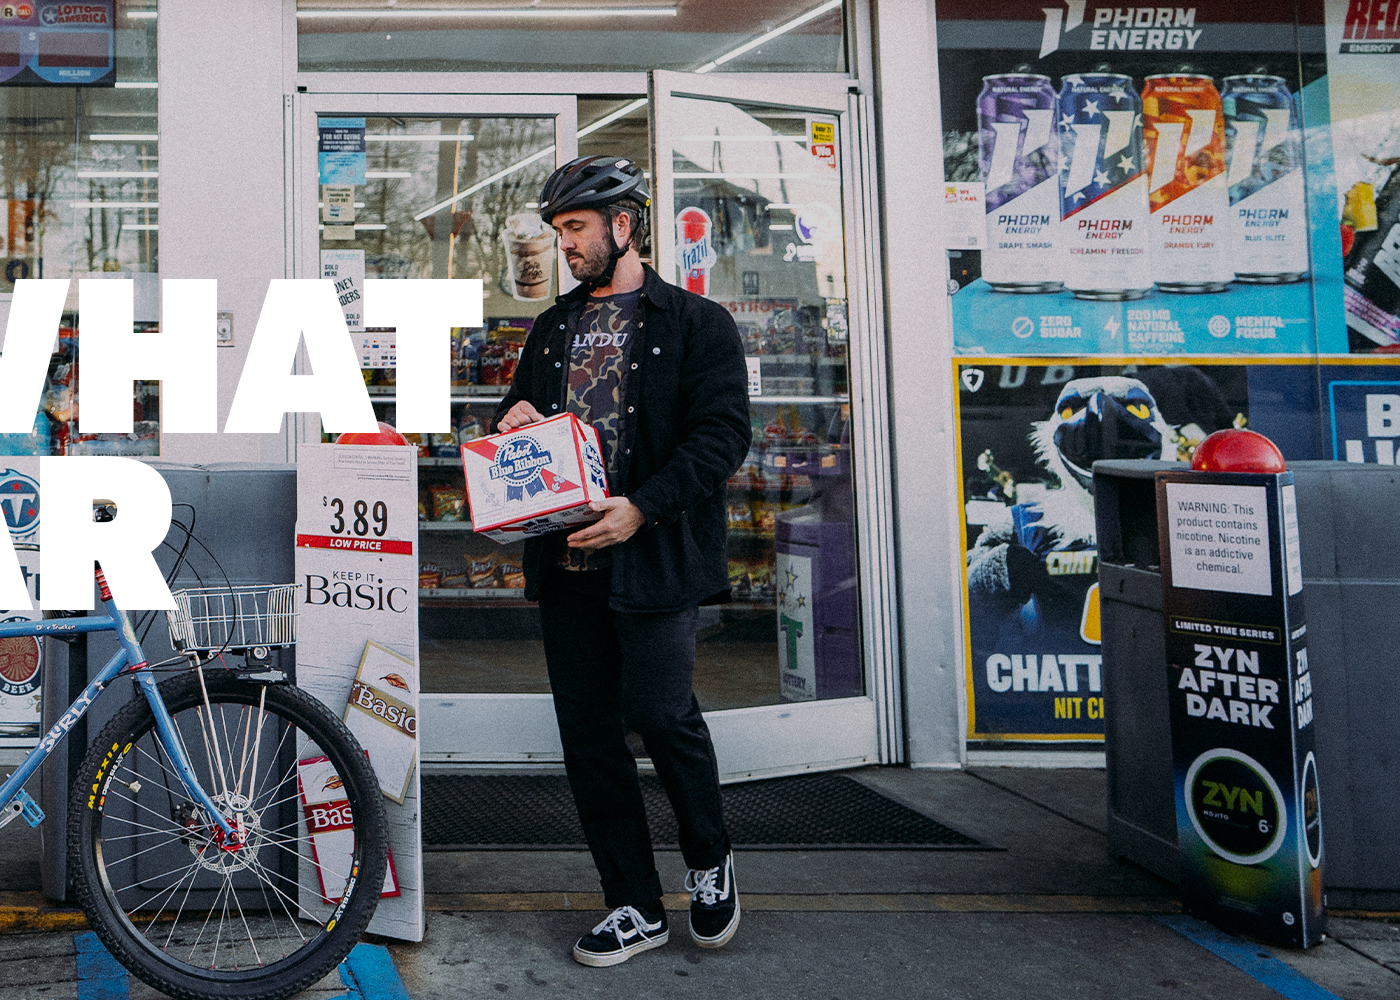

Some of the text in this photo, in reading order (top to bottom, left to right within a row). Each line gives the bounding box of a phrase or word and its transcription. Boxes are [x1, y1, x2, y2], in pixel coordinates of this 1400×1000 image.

[57, 5, 91, 13] LOTTO
[57, 12, 108, 24] AMERICA
[1093, 7, 1197, 29] PHORM
[1089, 29, 1202, 51] ENERGY
[1349, 43, 1394, 53] ENERGY
[59, 69, 90, 77] MILLION
[998, 215, 1050, 226] PHORM
[1162, 215, 1214, 226] PHORM
[1238, 209, 1289, 220] PHORM
[1078, 219, 1133, 231] PHORM
[1085, 232, 1123, 240] ENERGY
[1039, 316, 1072, 327] ZERO
[1127, 321, 1182, 332] NATURAL
[1235, 316, 1285, 327] MENTAL
[1040, 327, 1082, 338] SUGAR
[1128, 331, 1186, 343] CAFFEINE
[1235, 327, 1276, 338] FOCUS
[503, 441, 533, 462] Pabst
[491, 454, 550, 480] Blue Ribbon
[1178, 501, 1254, 515] WARNING: This
[1177, 517, 1258, 530] product contains
[330, 539, 382, 550] LOW PRICE
[1176, 531, 1261, 546] nicotine. Nicotine
[1184, 545, 1254, 560] is an addictive
[1196, 561, 1243, 574] chemical.
[333, 570, 376, 582] KEEP IT
[304, 573, 408, 613] Basic
[1175, 621, 1275, 640] LIMITED TIME SERIES
[1194, 643, 1260, 675] ZYN
[2, 682, 34, 694] BEER
[1178, 667, 1279, 704] AFTER
[356, 685, 417, 734] Basic
[1186, 693, 1275, 729] DARK
[40, 691, 91, 753] SURLY
[88, 742, 119, 810] MAXXIS
[1202, 780, 1264, 816] ZYN
[313, 806, 353, 830] Bas
[1203, 810, 1229, 820] MOJITO
[1258, 819, 1269, 834] 6
